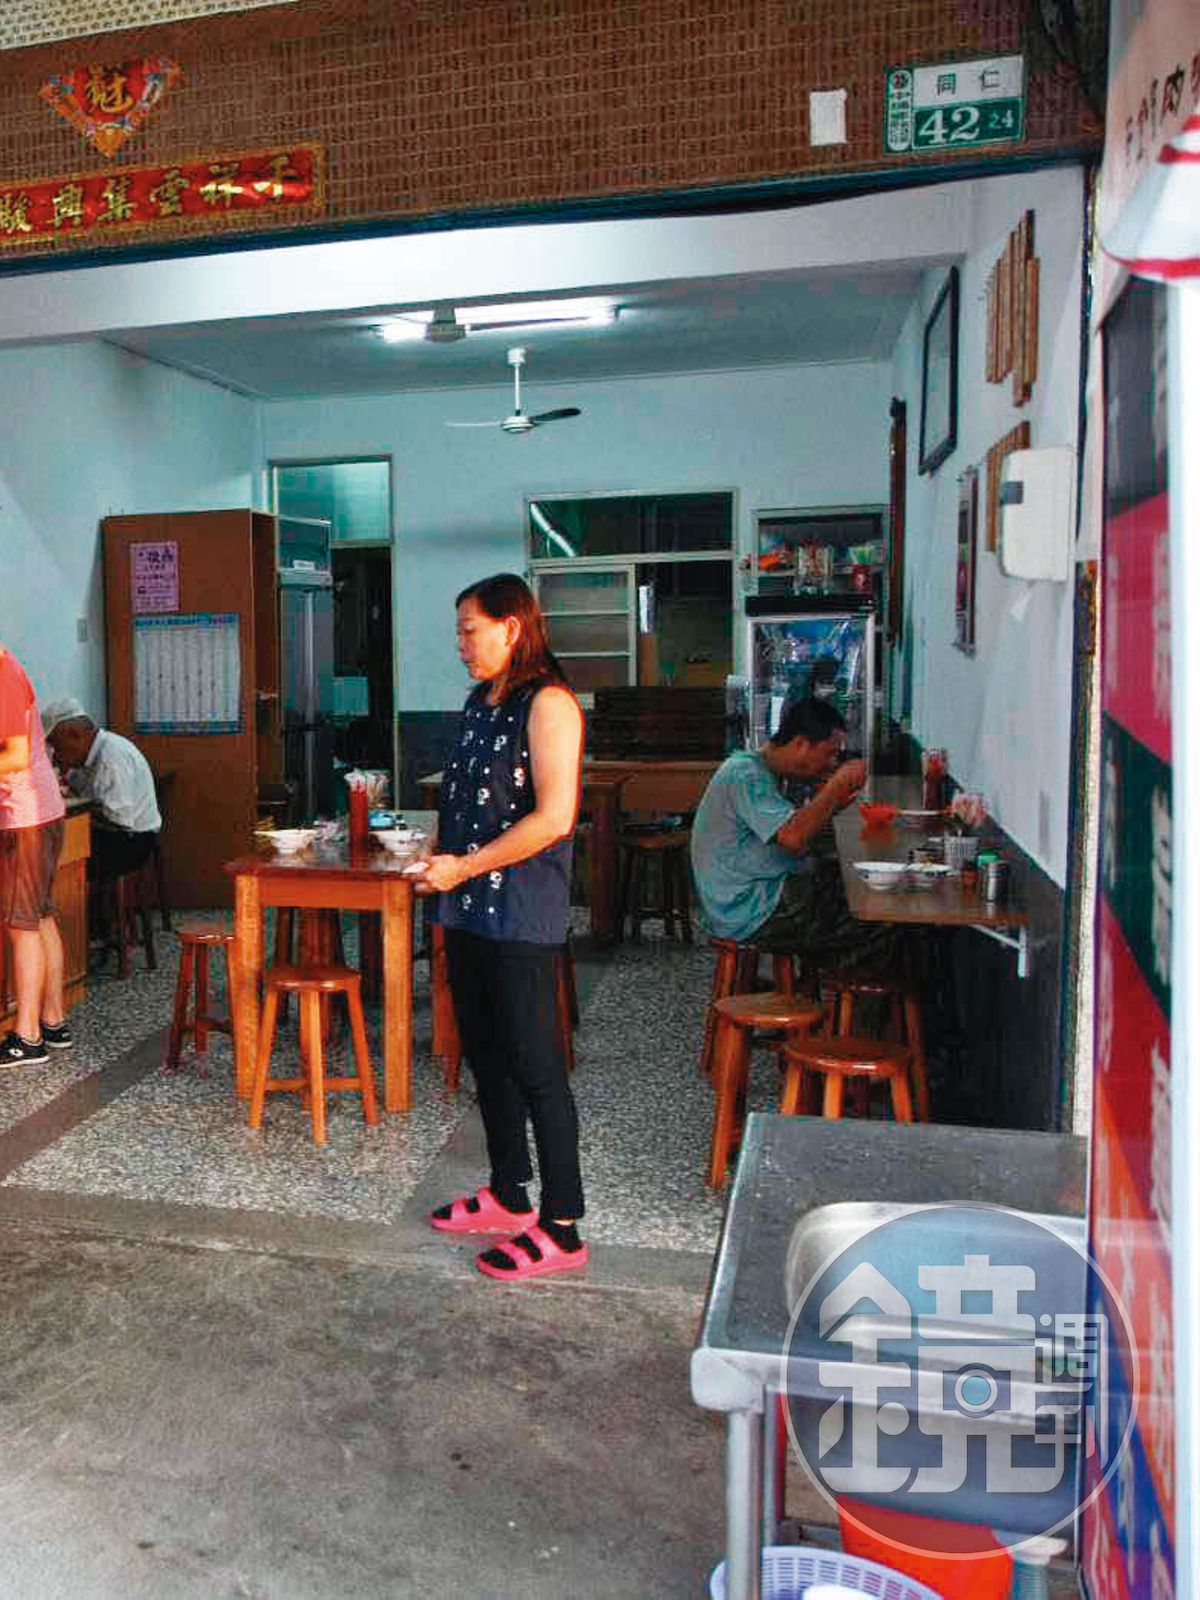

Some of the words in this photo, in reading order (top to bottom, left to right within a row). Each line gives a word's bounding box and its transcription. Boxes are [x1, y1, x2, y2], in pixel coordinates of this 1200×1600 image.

[937, 69, 1000, 97] 同仁
[918, 106, 981, 145] 42
[987, 109, 1013, 130] 24
